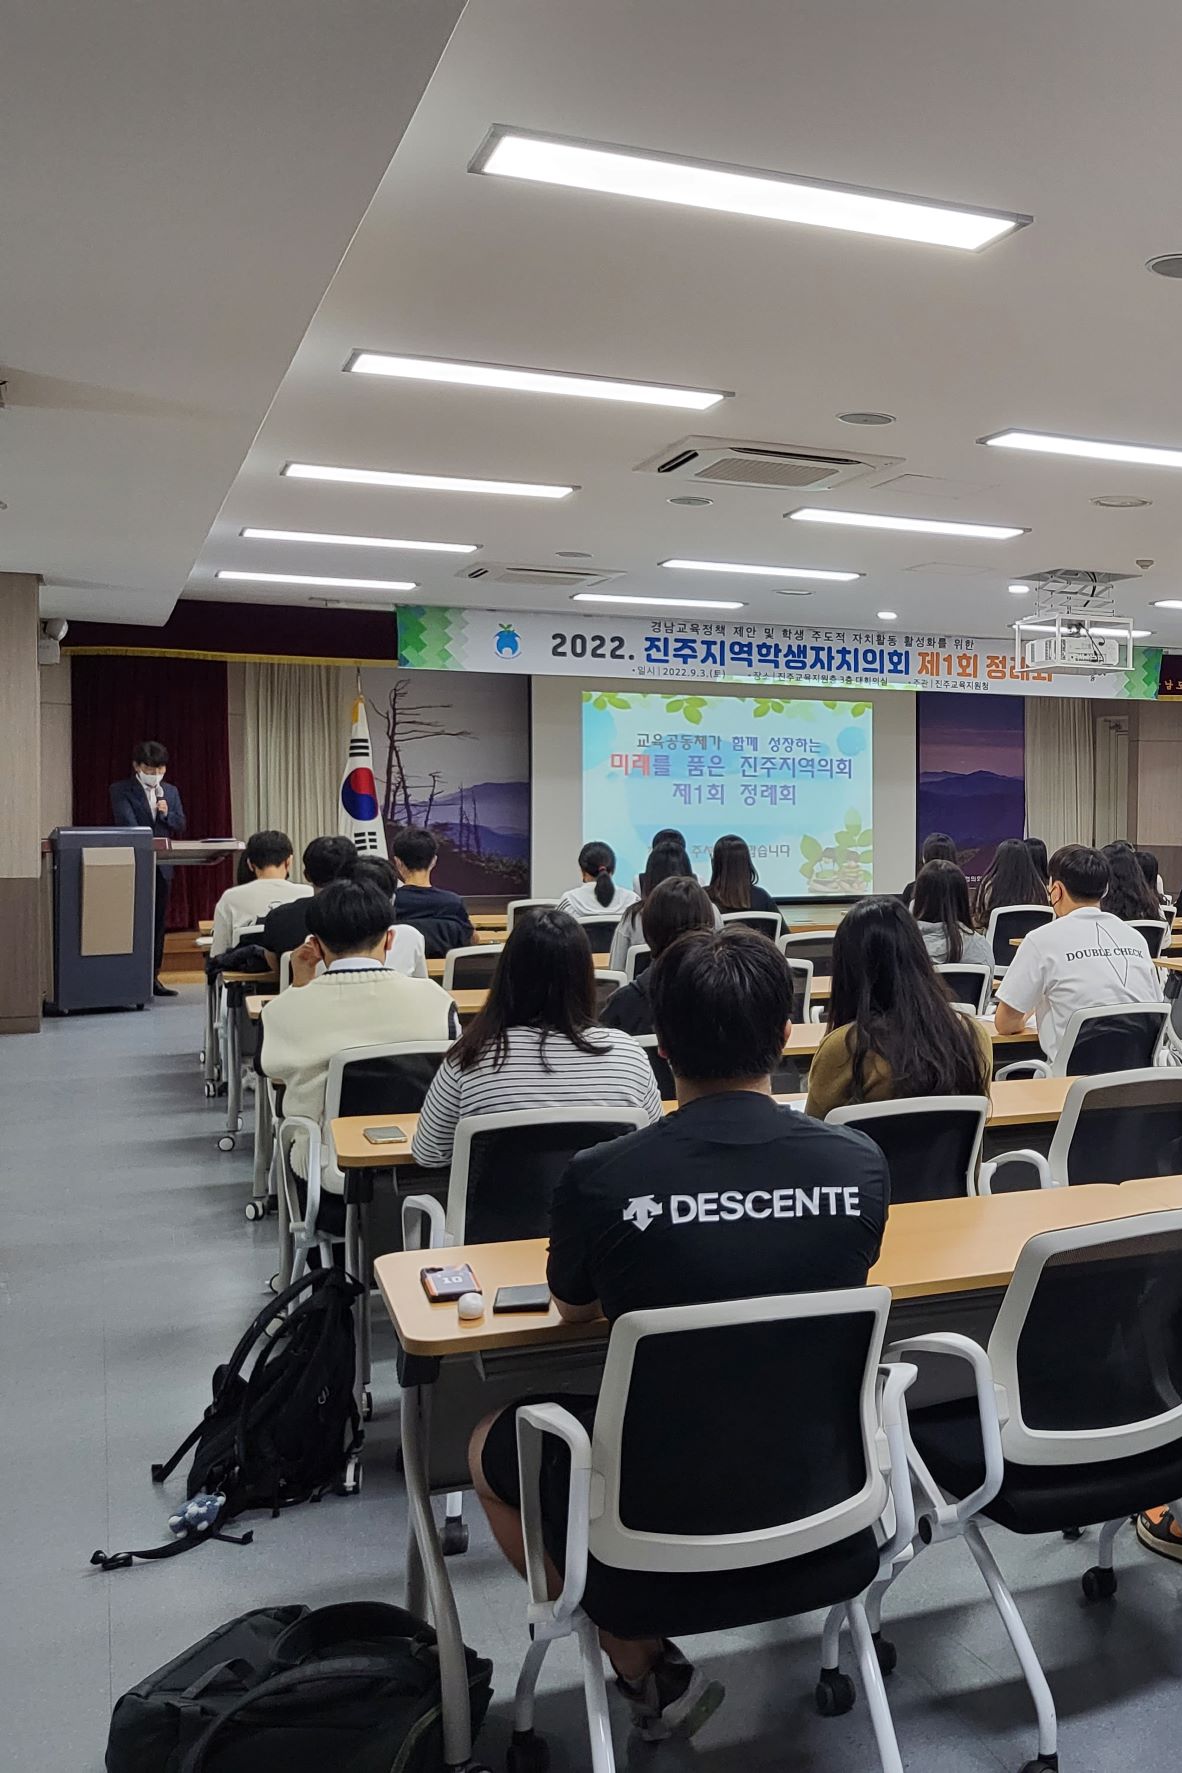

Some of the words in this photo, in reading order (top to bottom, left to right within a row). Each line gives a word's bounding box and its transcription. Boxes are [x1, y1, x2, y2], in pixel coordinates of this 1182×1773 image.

[651, 621, 726, 636] 경남교육정책
[733, 625, 756, 639] 제안
[764, 627, 775, 640] 및
[782, 628, 805, 641] 학생
[812, 630, 846, 643] 주도적
[852, 632, 897, 646] 자치활동
[904, 635, 947, 649] 활성화를
[953, 639, 975, 650] 위한
[551, 633, 635, 661] 2022.
[644, 636, 910, 675] 진주지역학생자치의회
[917, 651, 978, 678] 제1회
[935, 680, 989, 690] 진주교육지원청
[637, 734, 722, 750] 교육공동체가
[732, 736, 759, 752] 함께
[768, 737, 822, 753] 성장하는
[610, 754, 672, 777] 미래를
[687, 755, 725, 778] 품은
[740, 756, 853, 779] 진주지역의회
[673, 783, 725, 805] 제1회
[740, 784, 797, 806] 정례회
[1066, 948, 1112, 962] DOUBLE
[1113, 947, 1144, 959] CHECK
[670, 1186, 861, 1224] DESCENTE
